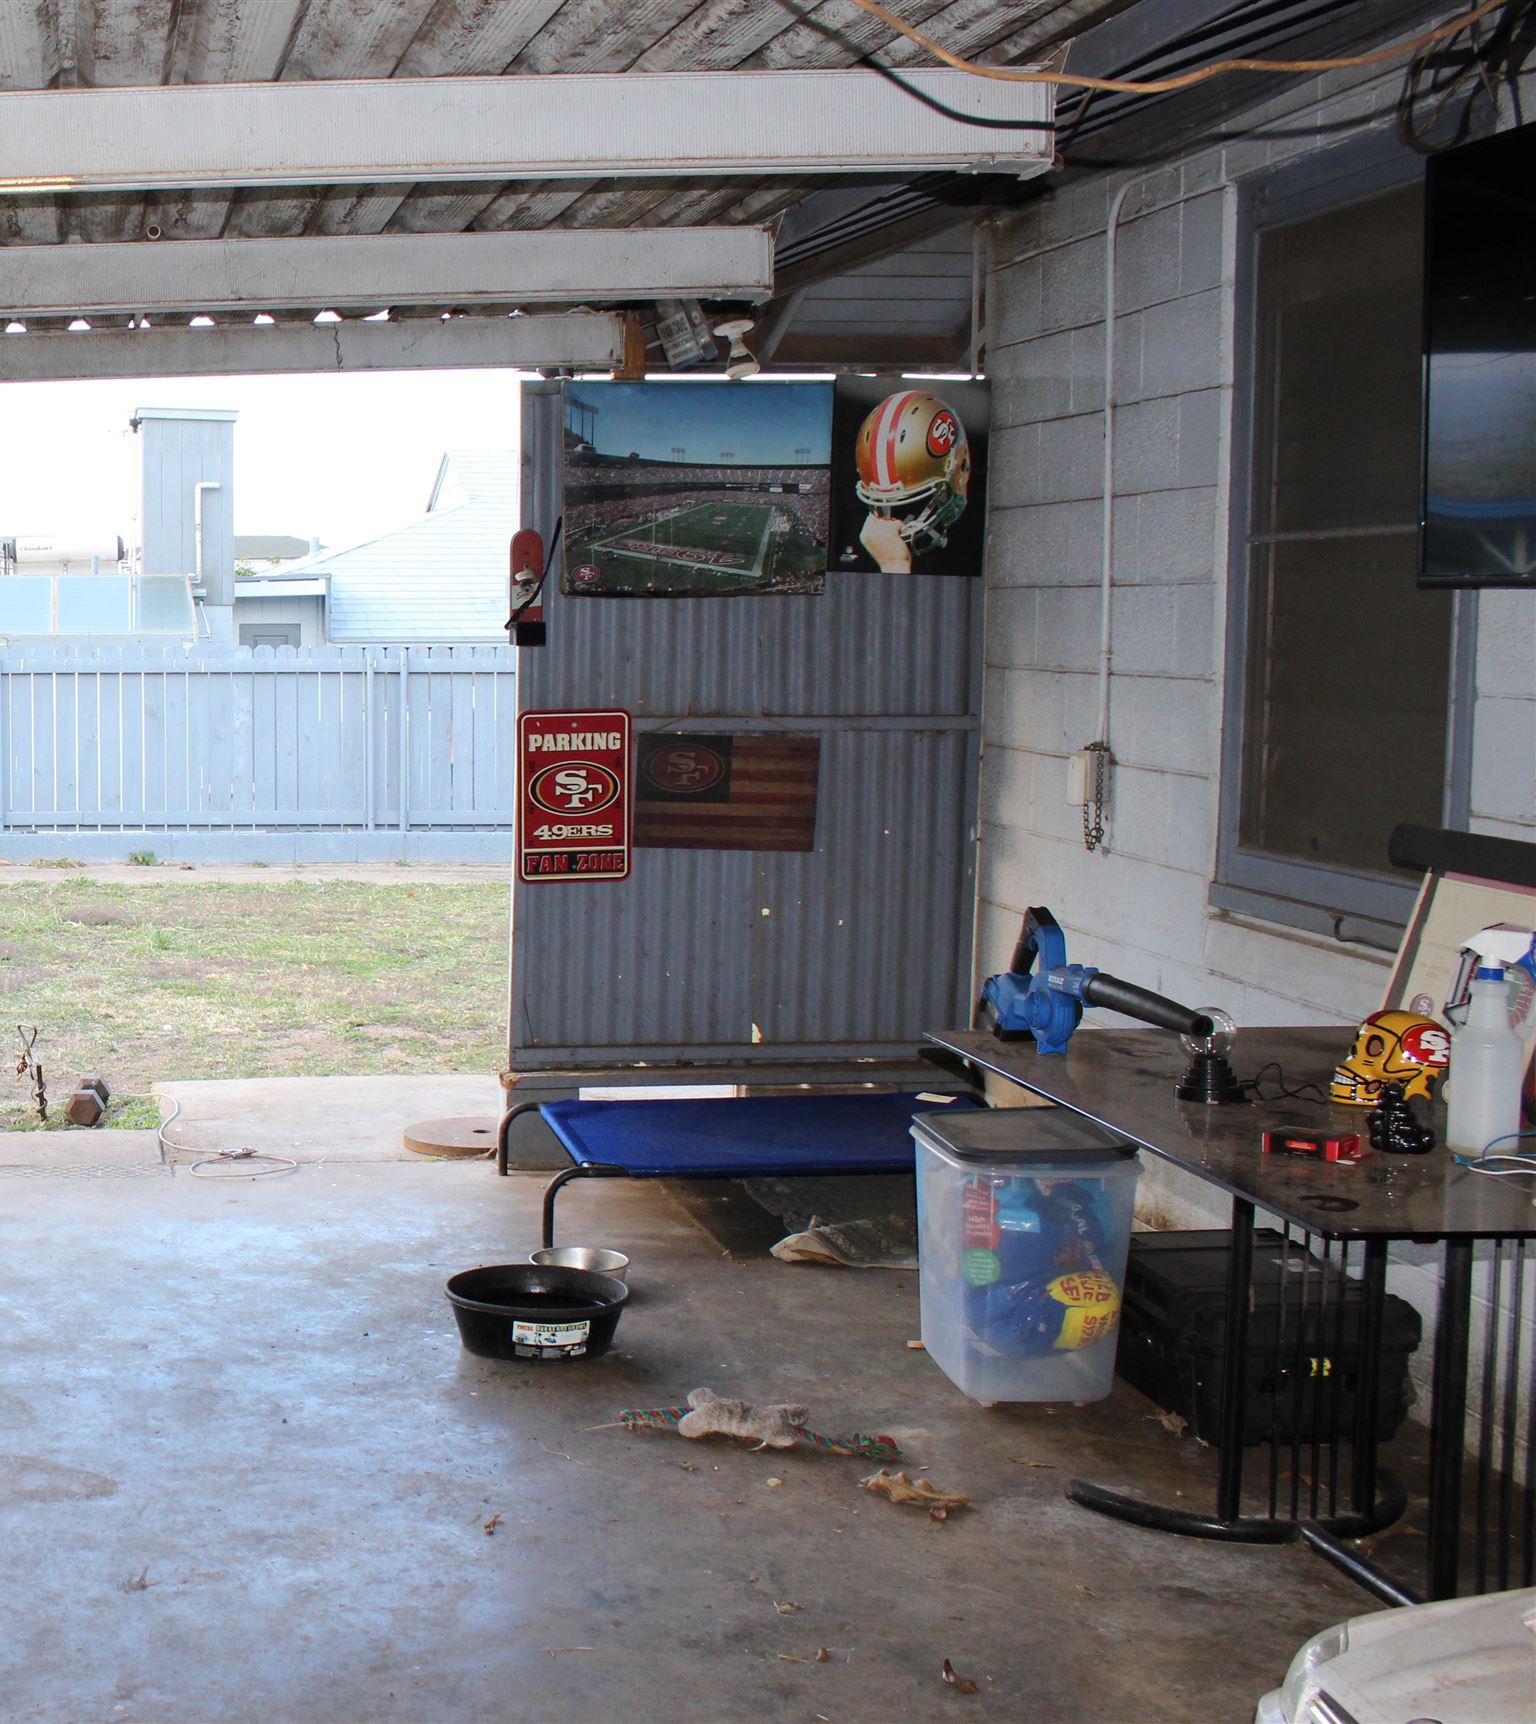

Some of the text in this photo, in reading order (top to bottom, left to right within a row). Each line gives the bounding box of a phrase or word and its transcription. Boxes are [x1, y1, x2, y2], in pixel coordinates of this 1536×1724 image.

[528, 732, 622, 753] PARKING
[554, 769, 603, 808] SF
[532, 824, 614, 840] 49ERS
[526, 852, 625, 874] FAN ZONE
